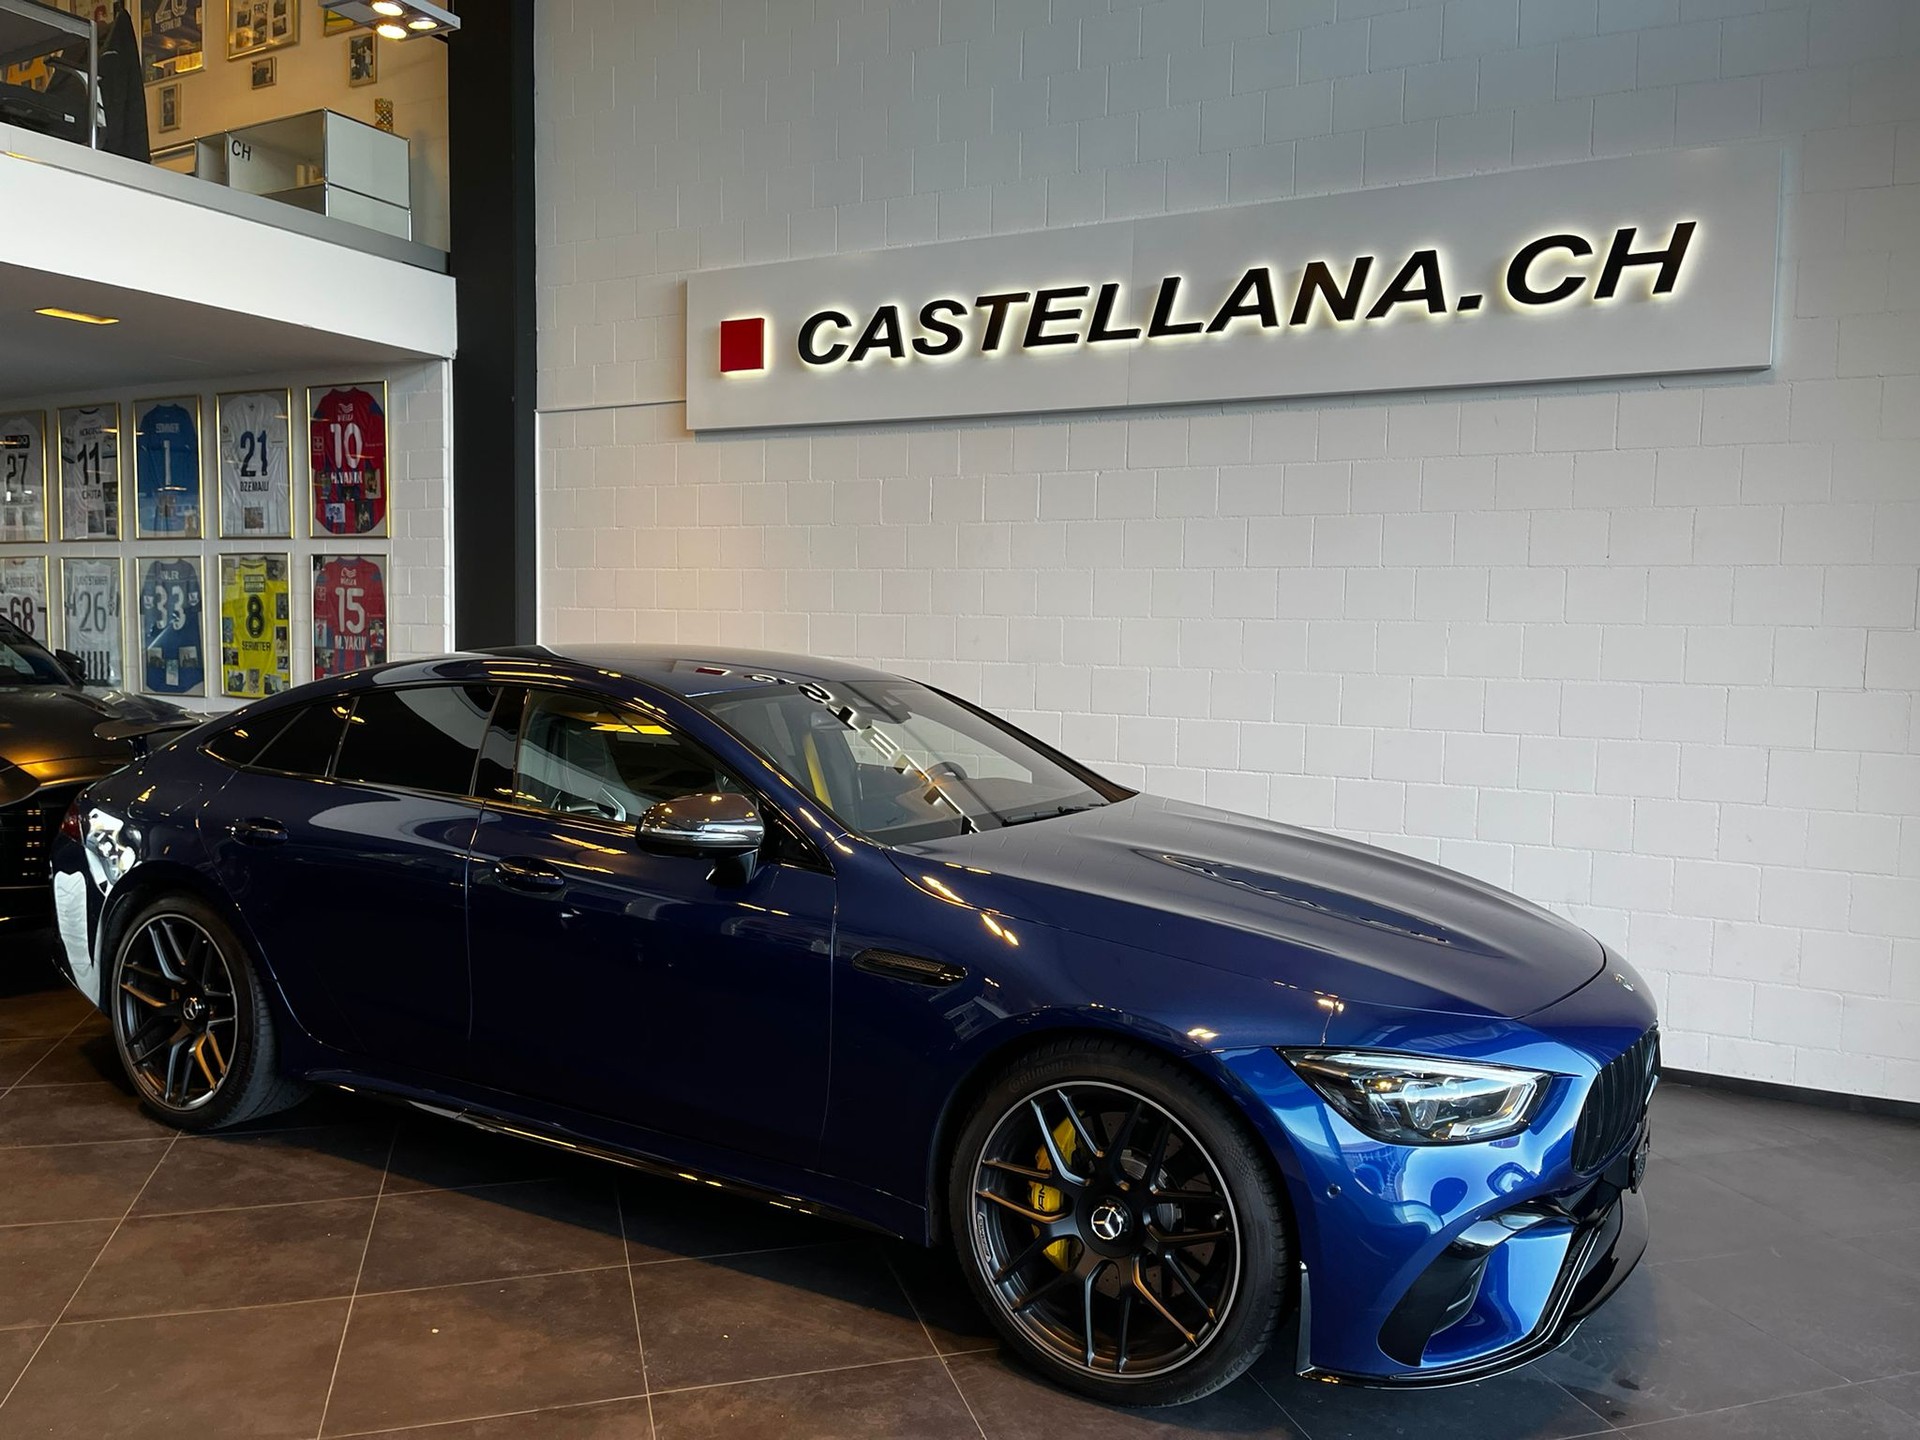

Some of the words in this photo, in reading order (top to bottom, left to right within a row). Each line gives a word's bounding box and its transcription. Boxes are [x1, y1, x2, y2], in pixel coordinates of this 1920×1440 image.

[231, 139, 251, 161] CH
[798, 220, 1699, 366] CASTELLANA.CH
[77, 442, 101, 485] 11
[240, 430, 268, 477] 21
[330, 422, 363, 469] 10
[6, 453, 29, 494] 27
[10, 596, 35, 636] 68
[79, 591, 107, 632] 26
[155, 585, 186, 630] 33
[246, 594, 265, 638] 8
[335, 587, 365, 634] 15
